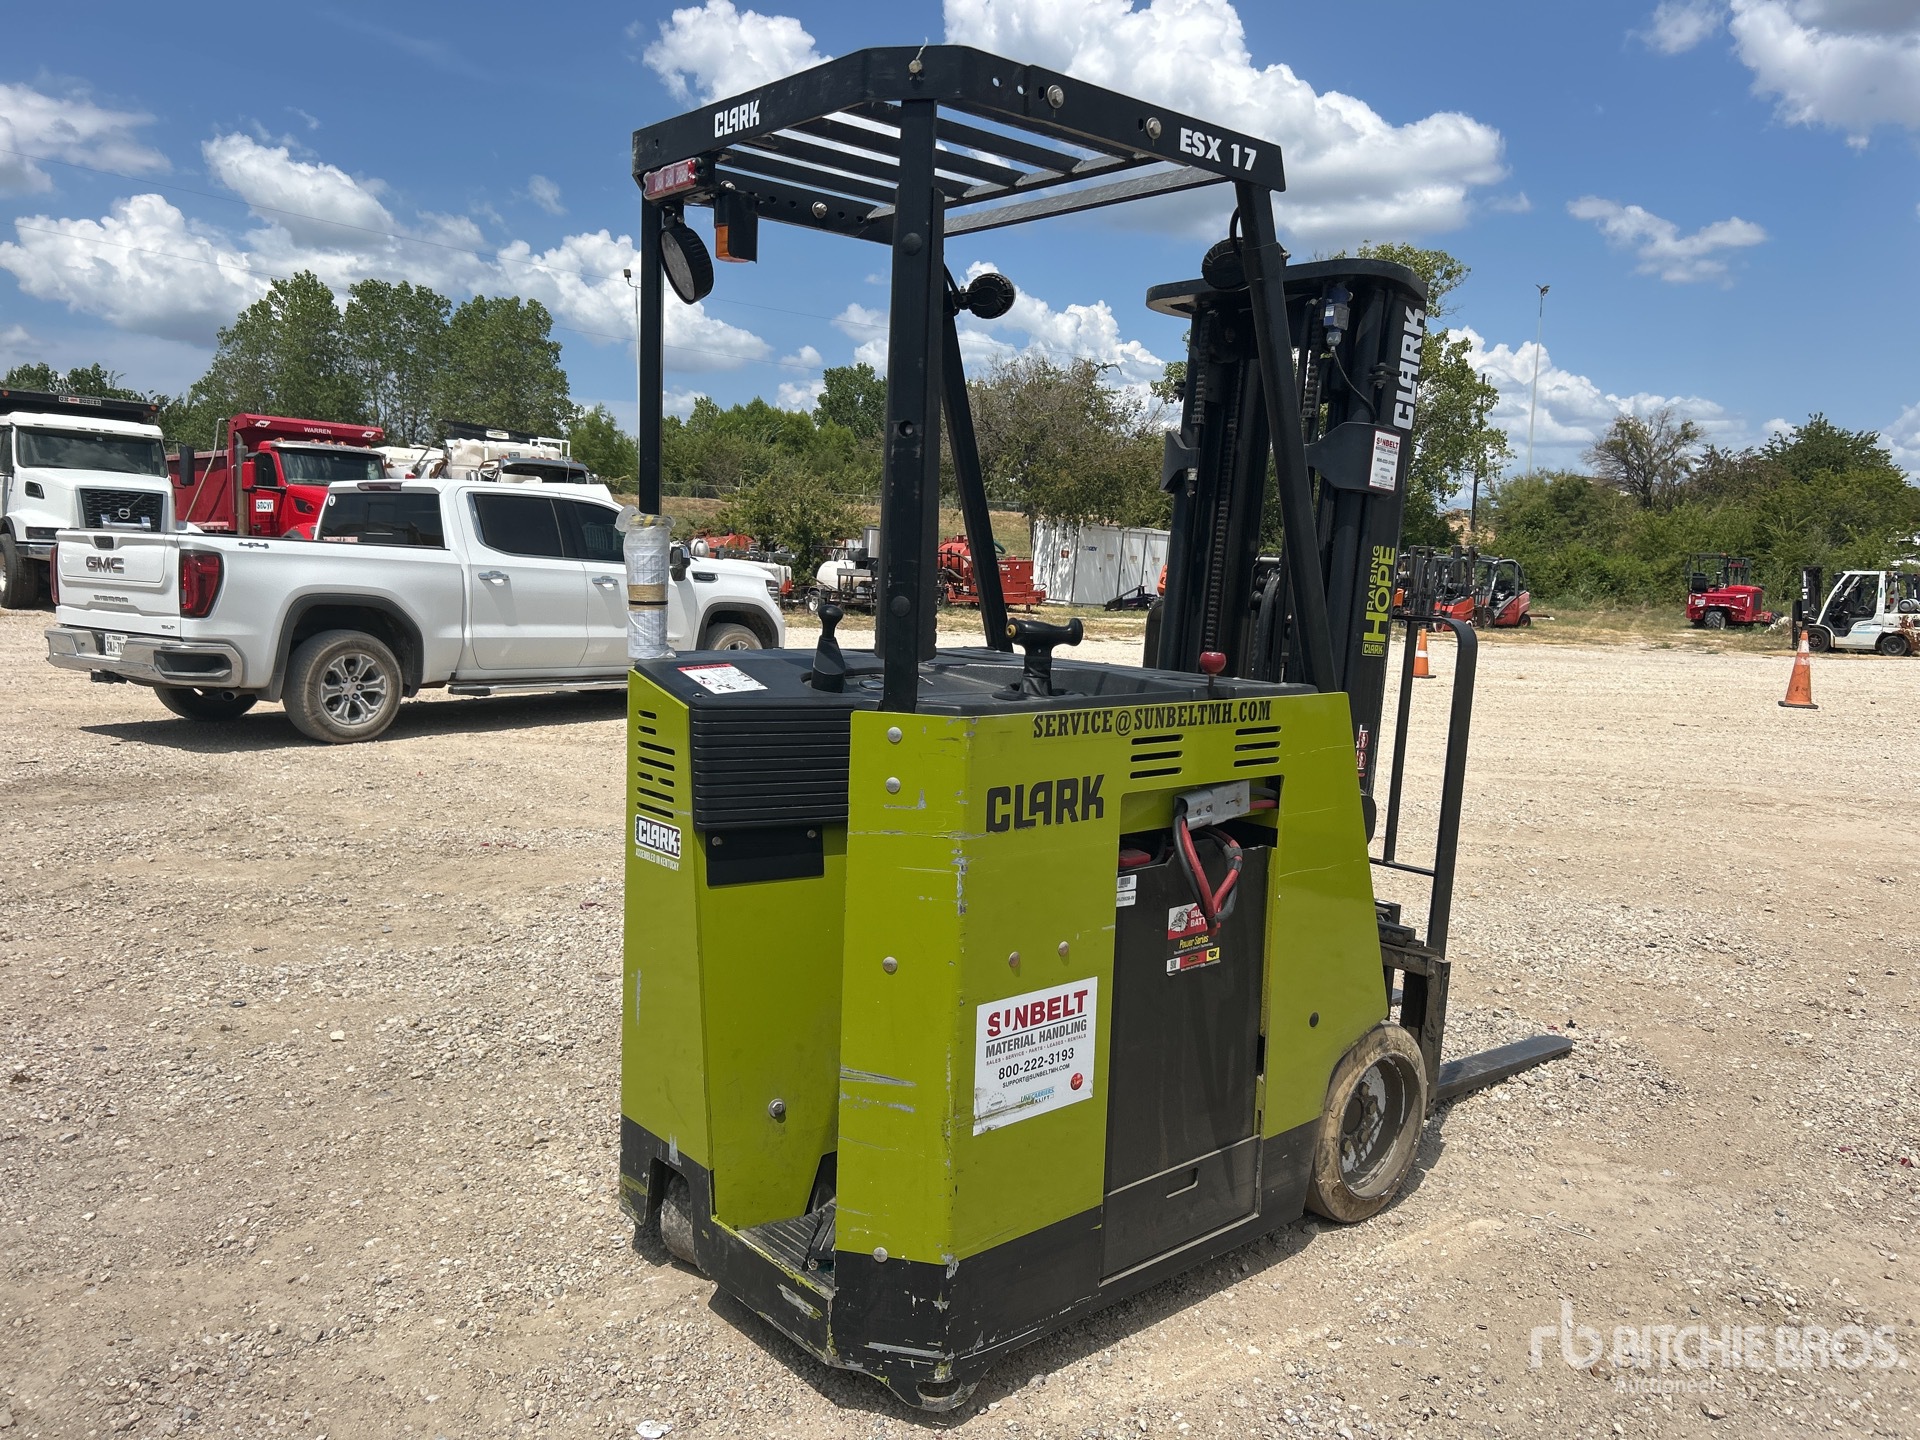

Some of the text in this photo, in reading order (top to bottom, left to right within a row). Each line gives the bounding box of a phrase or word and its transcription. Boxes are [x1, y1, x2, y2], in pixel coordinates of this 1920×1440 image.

[714, 99, 760, 138] CLARK
[1180, 127, 1258, 171] ESX 17
[1393, 306, 1425, 430] CLARK
[303, 426, 332, 435] WARREN
[1375, 437, 1399, 450] SUNBELT
[86, 556, 125, 573] GMC
[1367, 545, 1380, 611] RAISING
[1363, 545, 1396, 643] HOPE
[1363, 643, 1384, 655] CLARK
[1033, 700, 1272, 738] SERVICE@SUNBELTMH.COM
[986, 774, 1105, 833] CLARK
[638, 820, 678, 854] CLARK
[987, 989, 1088, 1037] SUNBELT
[985, 1019, 1087, 1058] MATERIAL HANDLING
[986, 1033, 1087, 1066] SALES SERVICE PARTS LEASES RENTALS
[998, 1047, 1074, 1080] 800-222-3193
[1002, 1063, 1071, 1088] SUPPORT@SUNBELTMH.COM
